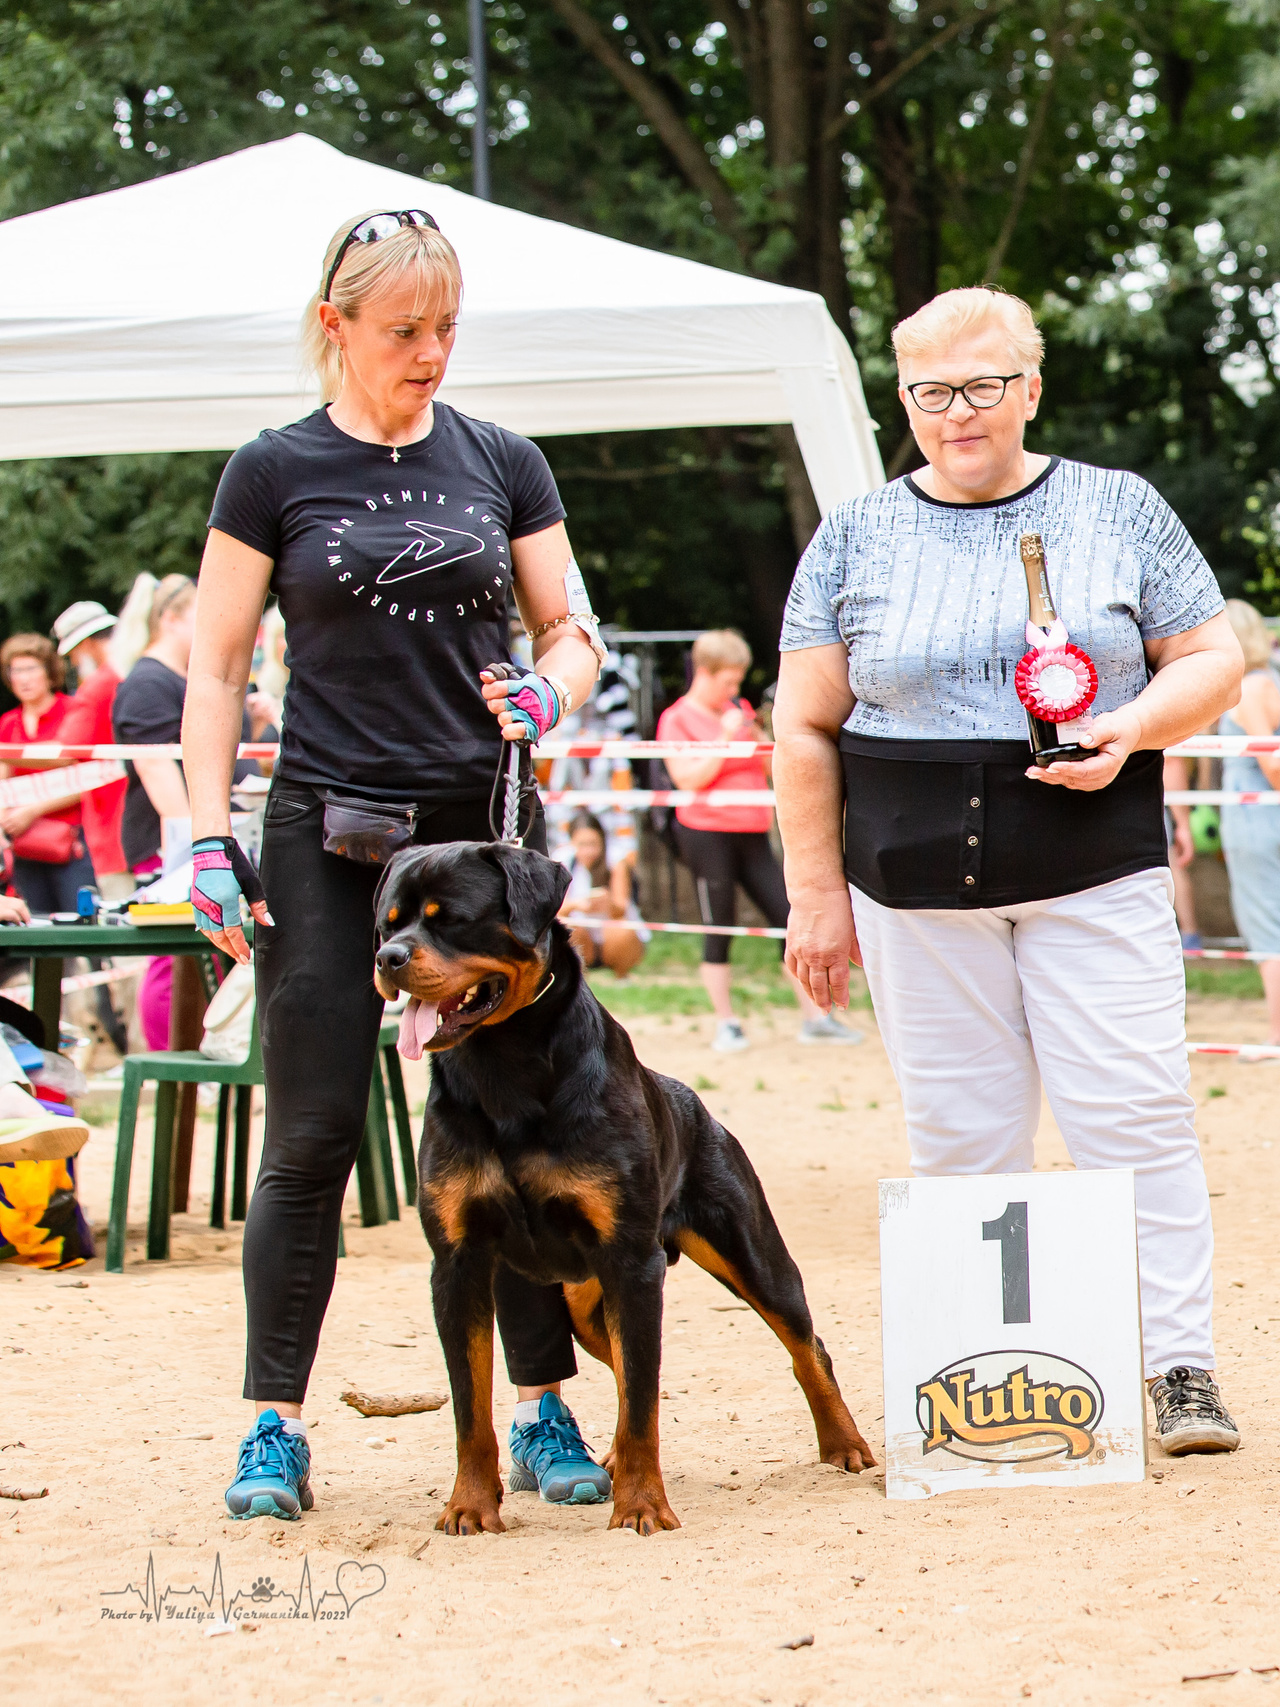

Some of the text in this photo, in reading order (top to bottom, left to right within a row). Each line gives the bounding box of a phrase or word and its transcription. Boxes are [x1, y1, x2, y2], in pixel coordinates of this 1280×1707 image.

[327, 489, 507, 623] DEMIX AUTHENTIC SPORTSWEAR
[982, 1201, 1031, 1324] 1
[917, 1365, 1096, 1455] Nutro
